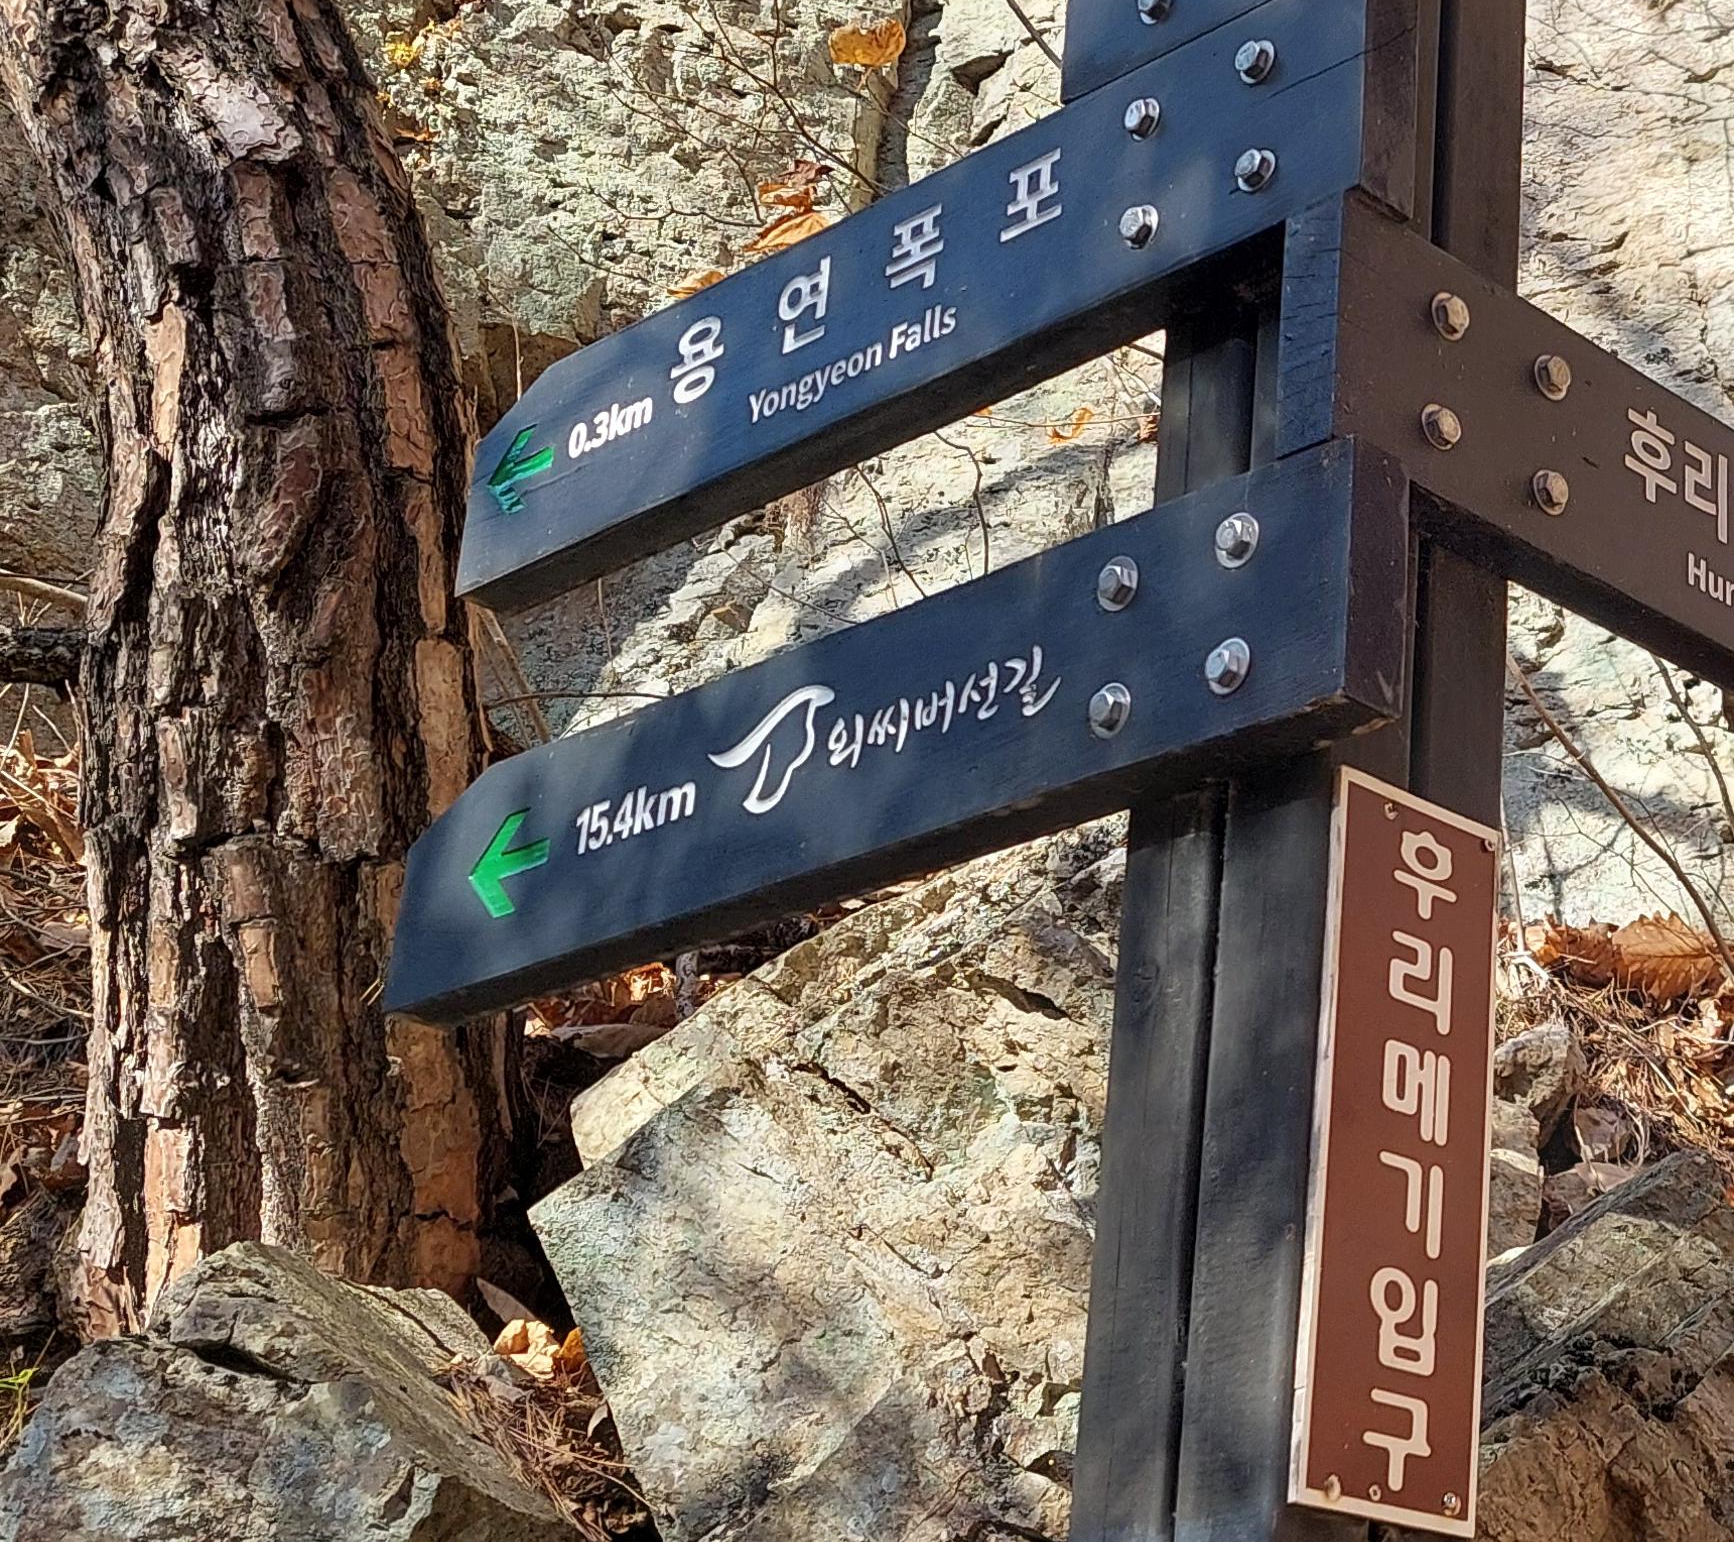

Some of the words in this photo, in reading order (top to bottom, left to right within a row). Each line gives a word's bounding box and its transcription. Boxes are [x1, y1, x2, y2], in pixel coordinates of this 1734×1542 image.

[749, 342, 882, 425] Yongyeon
[888, 304, 957, 360] Falls
[567, 394, 653, 459] 0.3km
[828, 645, 1062, 768] 외씨버선길
[575, 779, 695, 857] 15.4km
